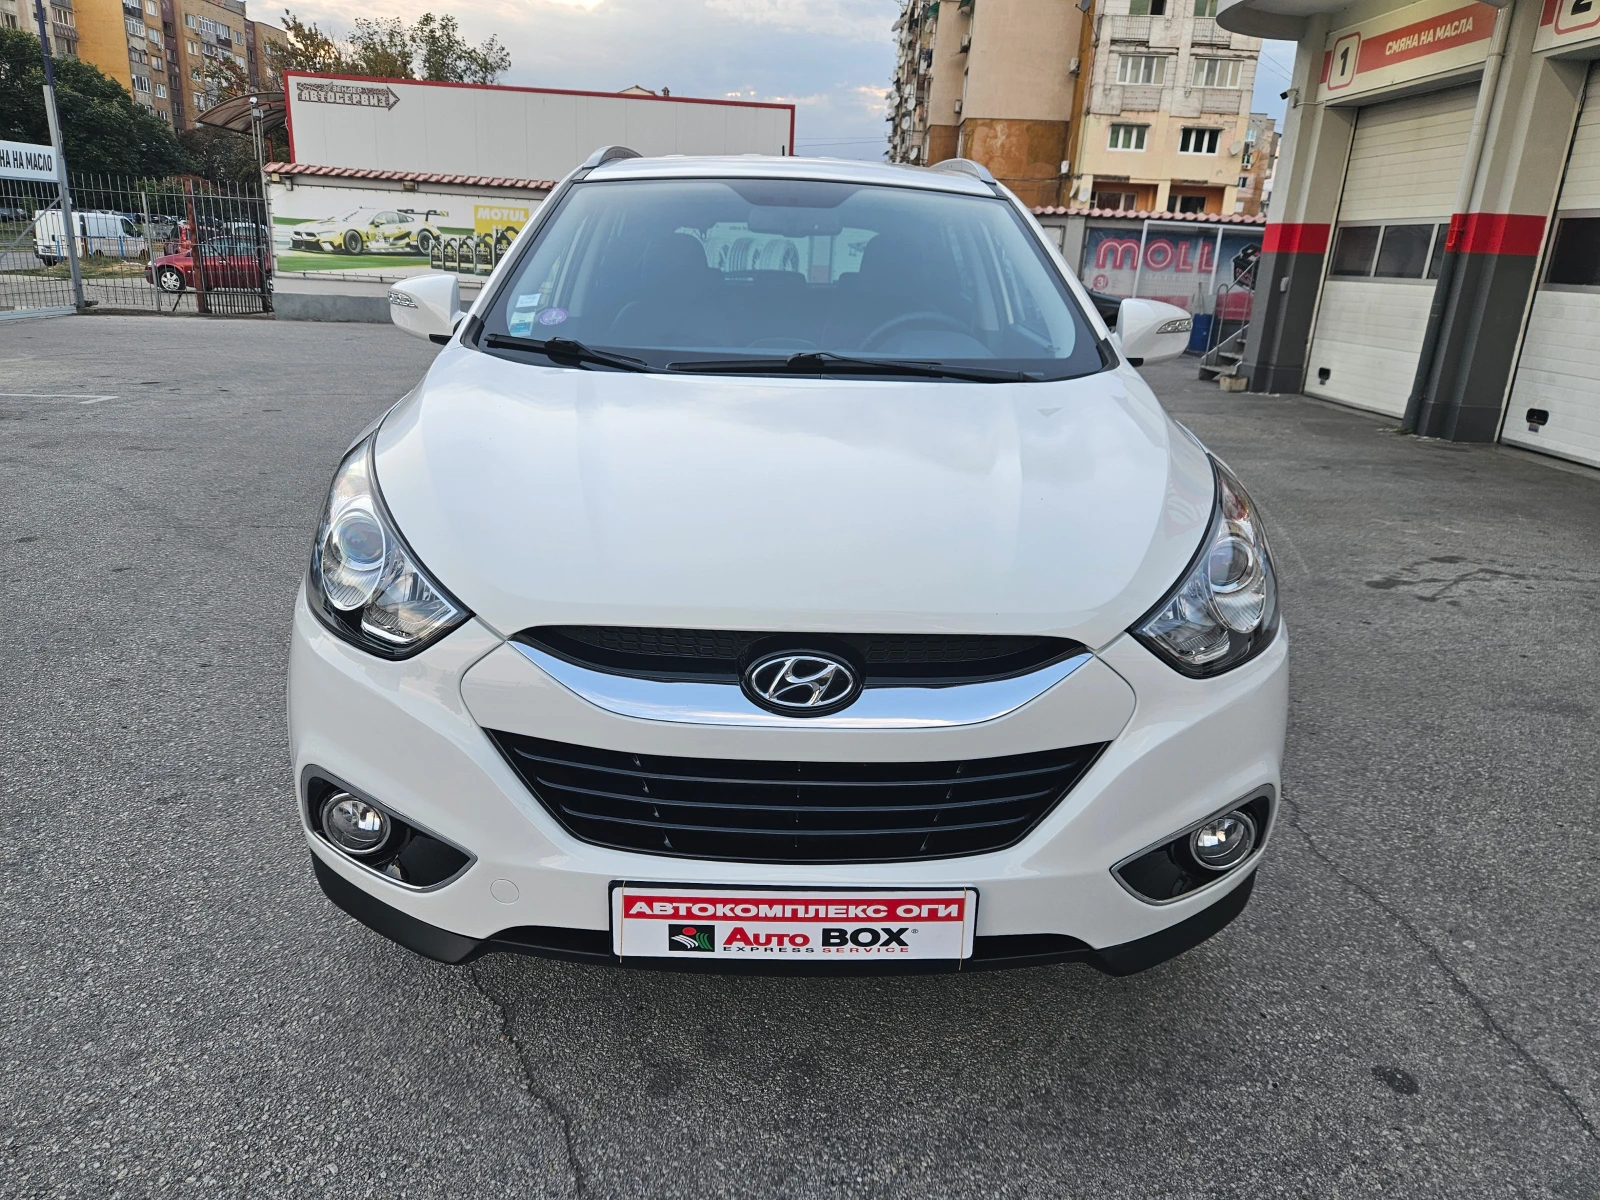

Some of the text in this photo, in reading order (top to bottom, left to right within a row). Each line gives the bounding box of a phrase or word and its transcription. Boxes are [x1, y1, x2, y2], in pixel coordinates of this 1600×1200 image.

[1385, 16, 1473, 56] СМЯНА НА МАСЛА
[1340, 47, 1350, 76] 1
[302, 90, 387, 107] АВТОСЕРВИЗ
[12, 150, 24, 169] НА
[25, 152, 52, 172] МАСЛО
[477, 207, 527, 222] MOTUL
[629, 902, 959, 918] АВТОКОМПЛЕКС ОГИ
